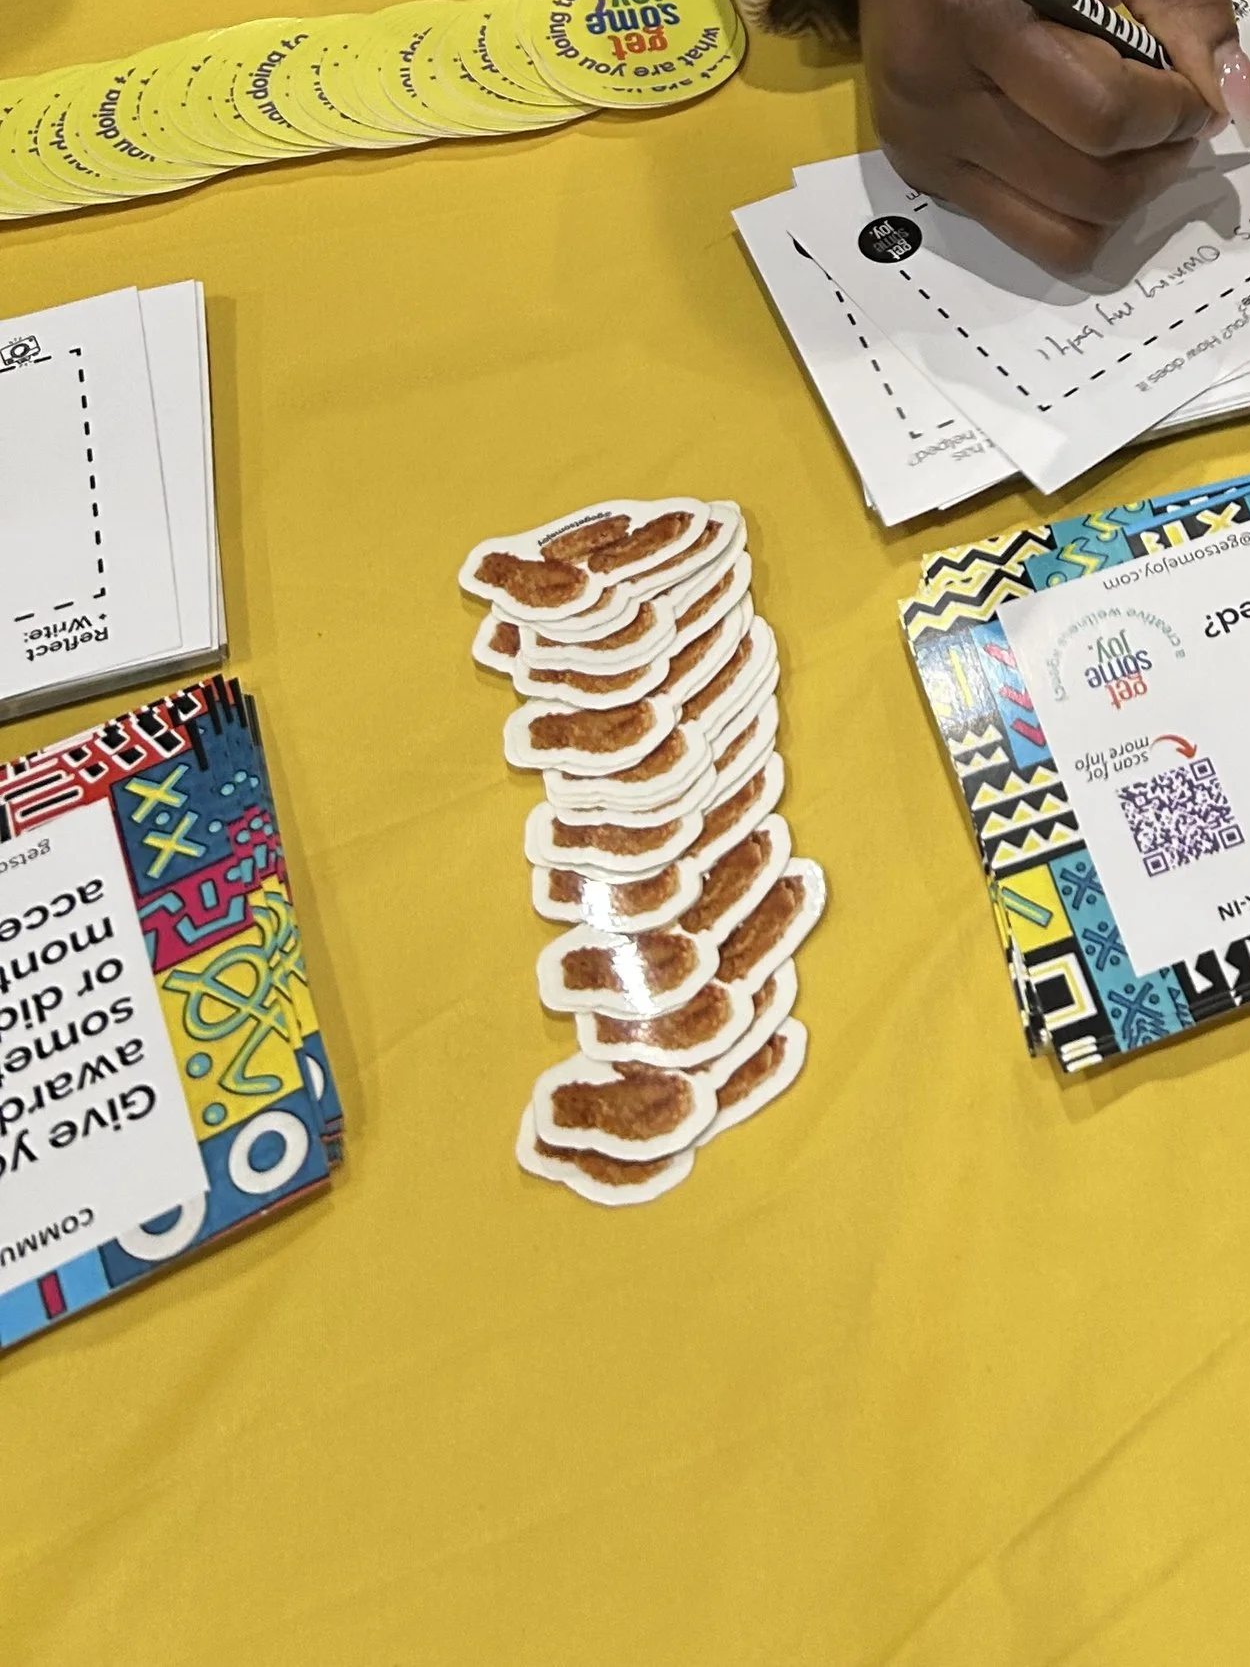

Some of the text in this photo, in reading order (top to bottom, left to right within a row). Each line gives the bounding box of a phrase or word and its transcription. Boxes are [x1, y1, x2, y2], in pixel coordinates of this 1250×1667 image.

[545, 11, 580, 59] doing
[585, 3, 680, 35] some
[607, 26, 668, 61] get
[676, 27, 720, 67] what
[578, 56, 626, 77] you
[633, 61, 676, 77] are
[869, 220, 894, 239] joy.
[873, 228, 910, 254] some
[887, 238, 911, 260] get
[1134, 244, 1221, 298] Owning
[1094, 301, 1135, 326] my
[1185, 335, 1221, 360] How
[1135, 380, 1149, 392] it
[1147, 357, 1185, 383] does
[24, 615, 93, 643] Write:
[26, 626, 109, 662] Reflect
[1087, 629, 1131, 663] joy.
[1084, 650, 1152, 688] some
[1104, 670, 1148, 710] get
[1074, 736, 1149, 772] more info
[1085, 751, 1149, 782] scan for
[0, 879, 104, 943] acce
[77, 958, 123, 997] or
[0, 996, 134, 1082] some
[0, 1038, 144, 1137] award
[49, 1084, 156, 1149] Give
[0, 1207, 94, 1267] COMMU
